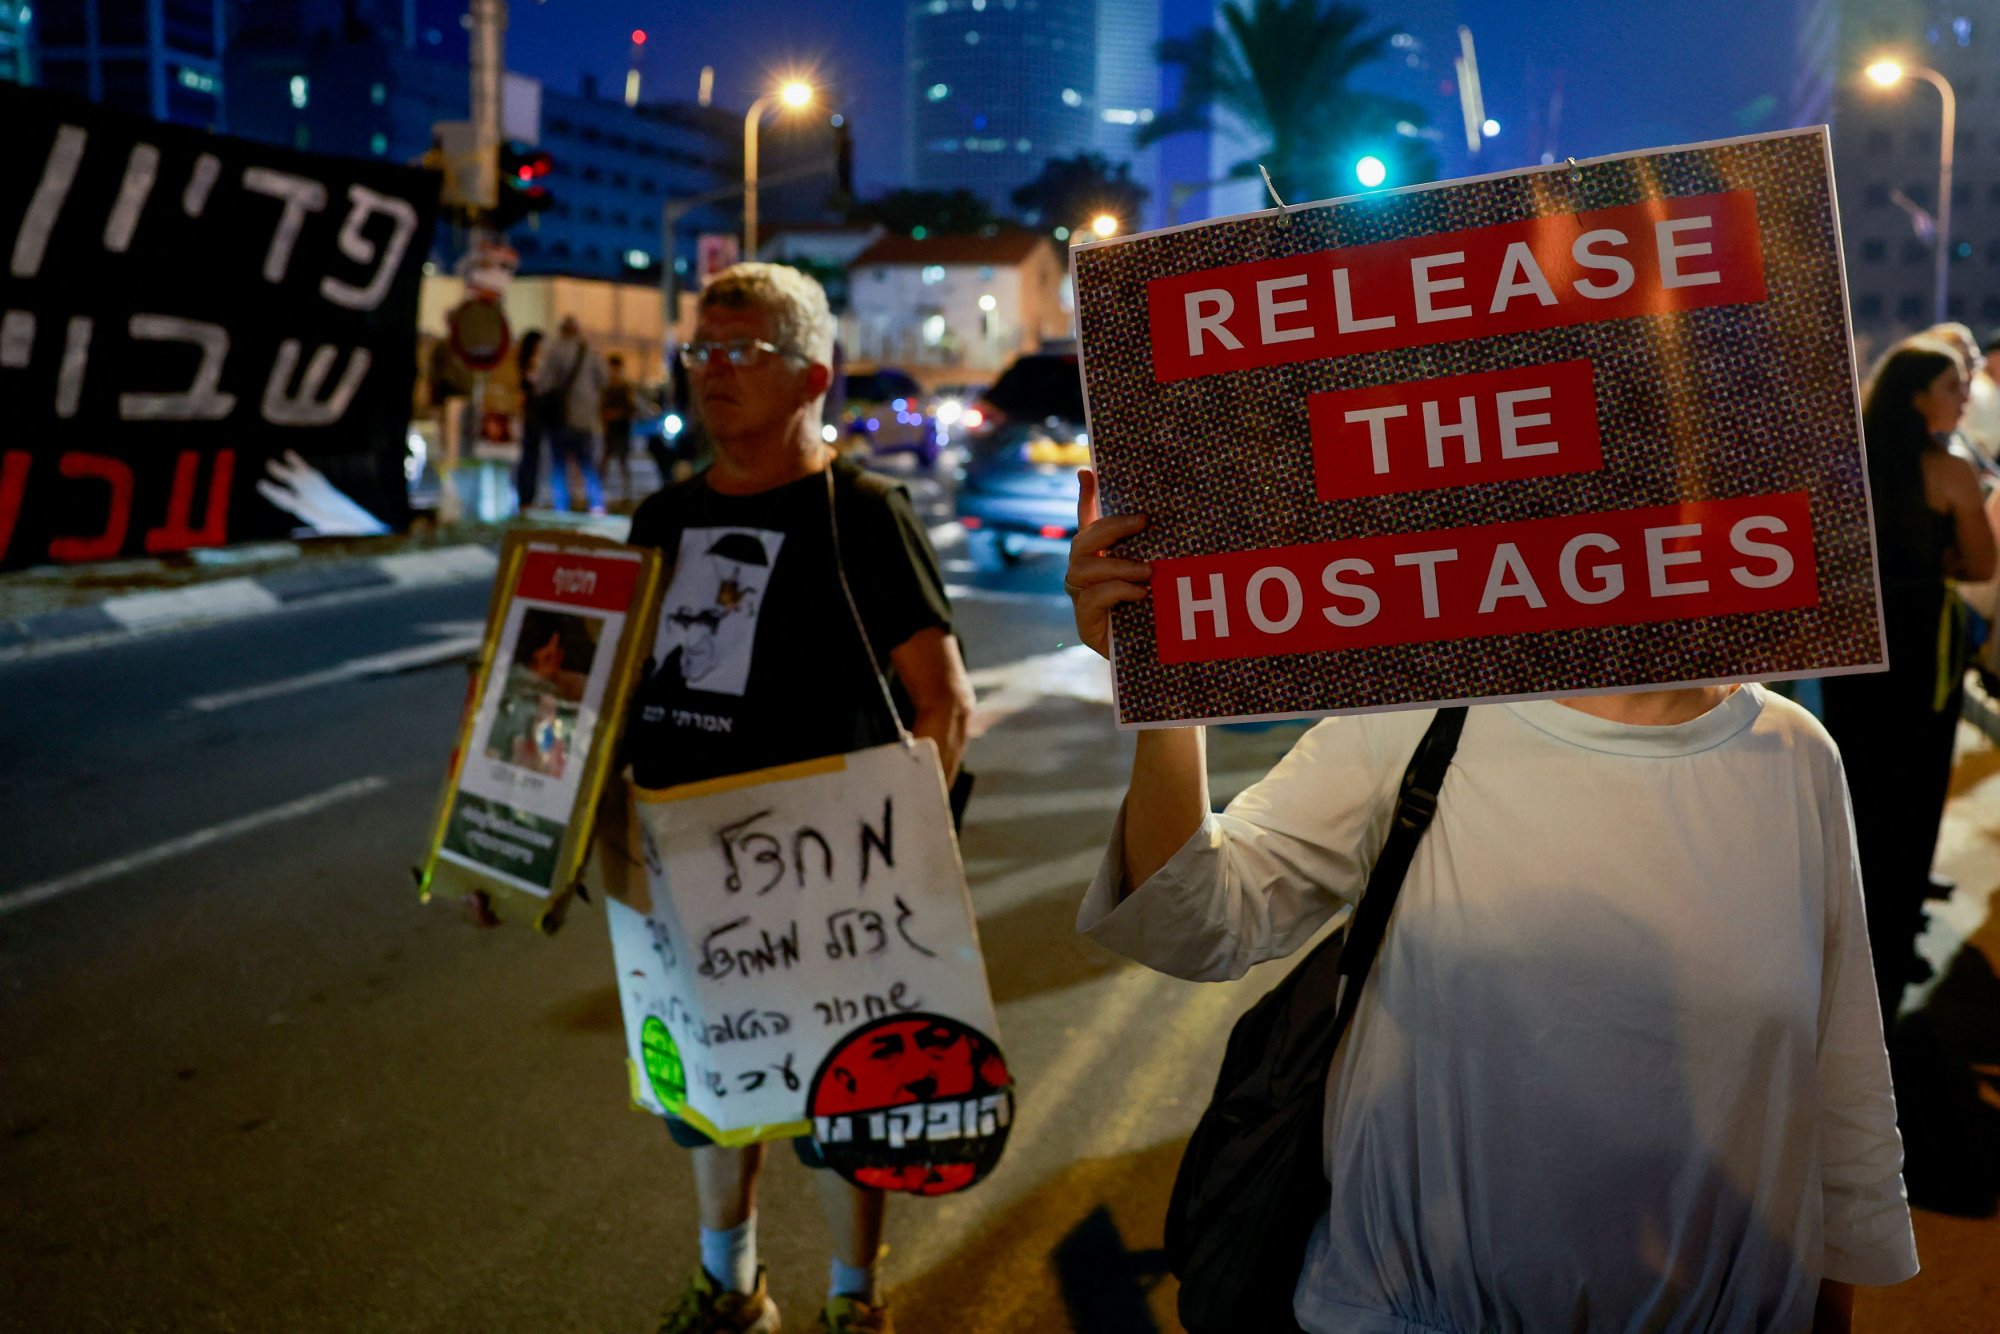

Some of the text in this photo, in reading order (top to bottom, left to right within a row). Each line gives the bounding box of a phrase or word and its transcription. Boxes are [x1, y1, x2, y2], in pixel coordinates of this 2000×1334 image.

[10, 123, 418, 311] פדיון
[1184, 215, 1723, 357] RELEASE
[1344, 386, 1560, 476] THE
[1175, 515, 1796, 642] HOSTAGES
[671, 708, 733, 733] אמרתי
[716, 797, 895, 896] מחדל
[825, 896, 937, 961] גדול
